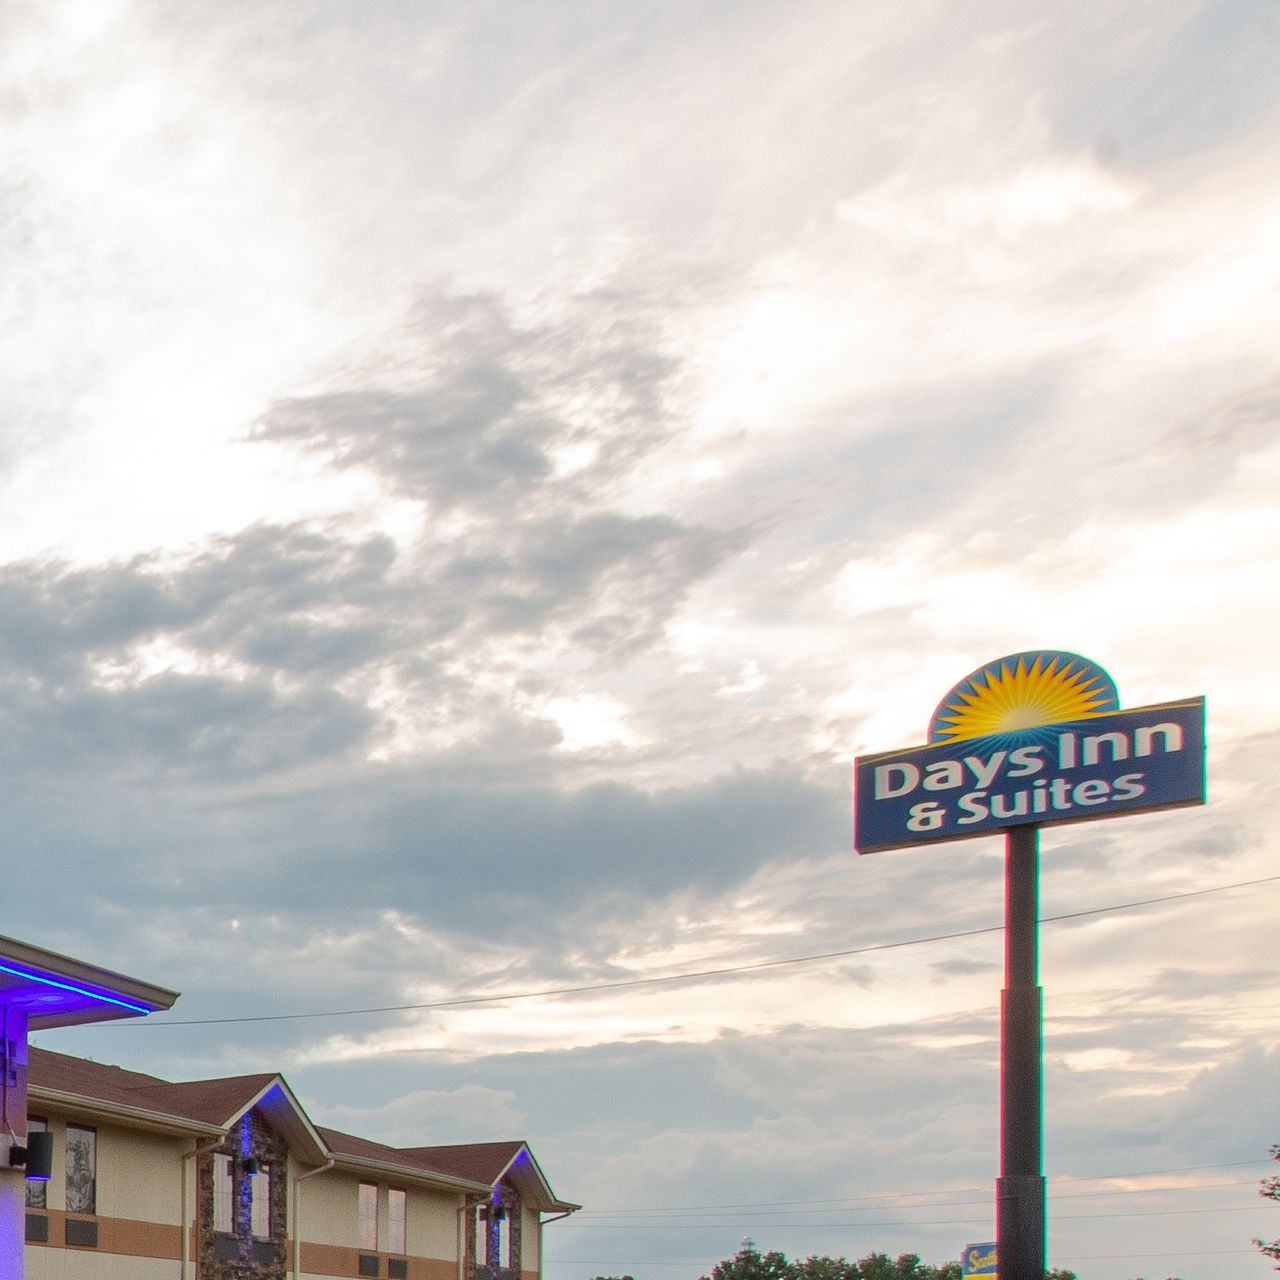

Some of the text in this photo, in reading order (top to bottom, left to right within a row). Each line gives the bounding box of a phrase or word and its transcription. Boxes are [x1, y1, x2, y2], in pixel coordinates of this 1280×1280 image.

[874, 722, 1184, 801] Days Inn
[905, 773, 1147, 832] & Suites
